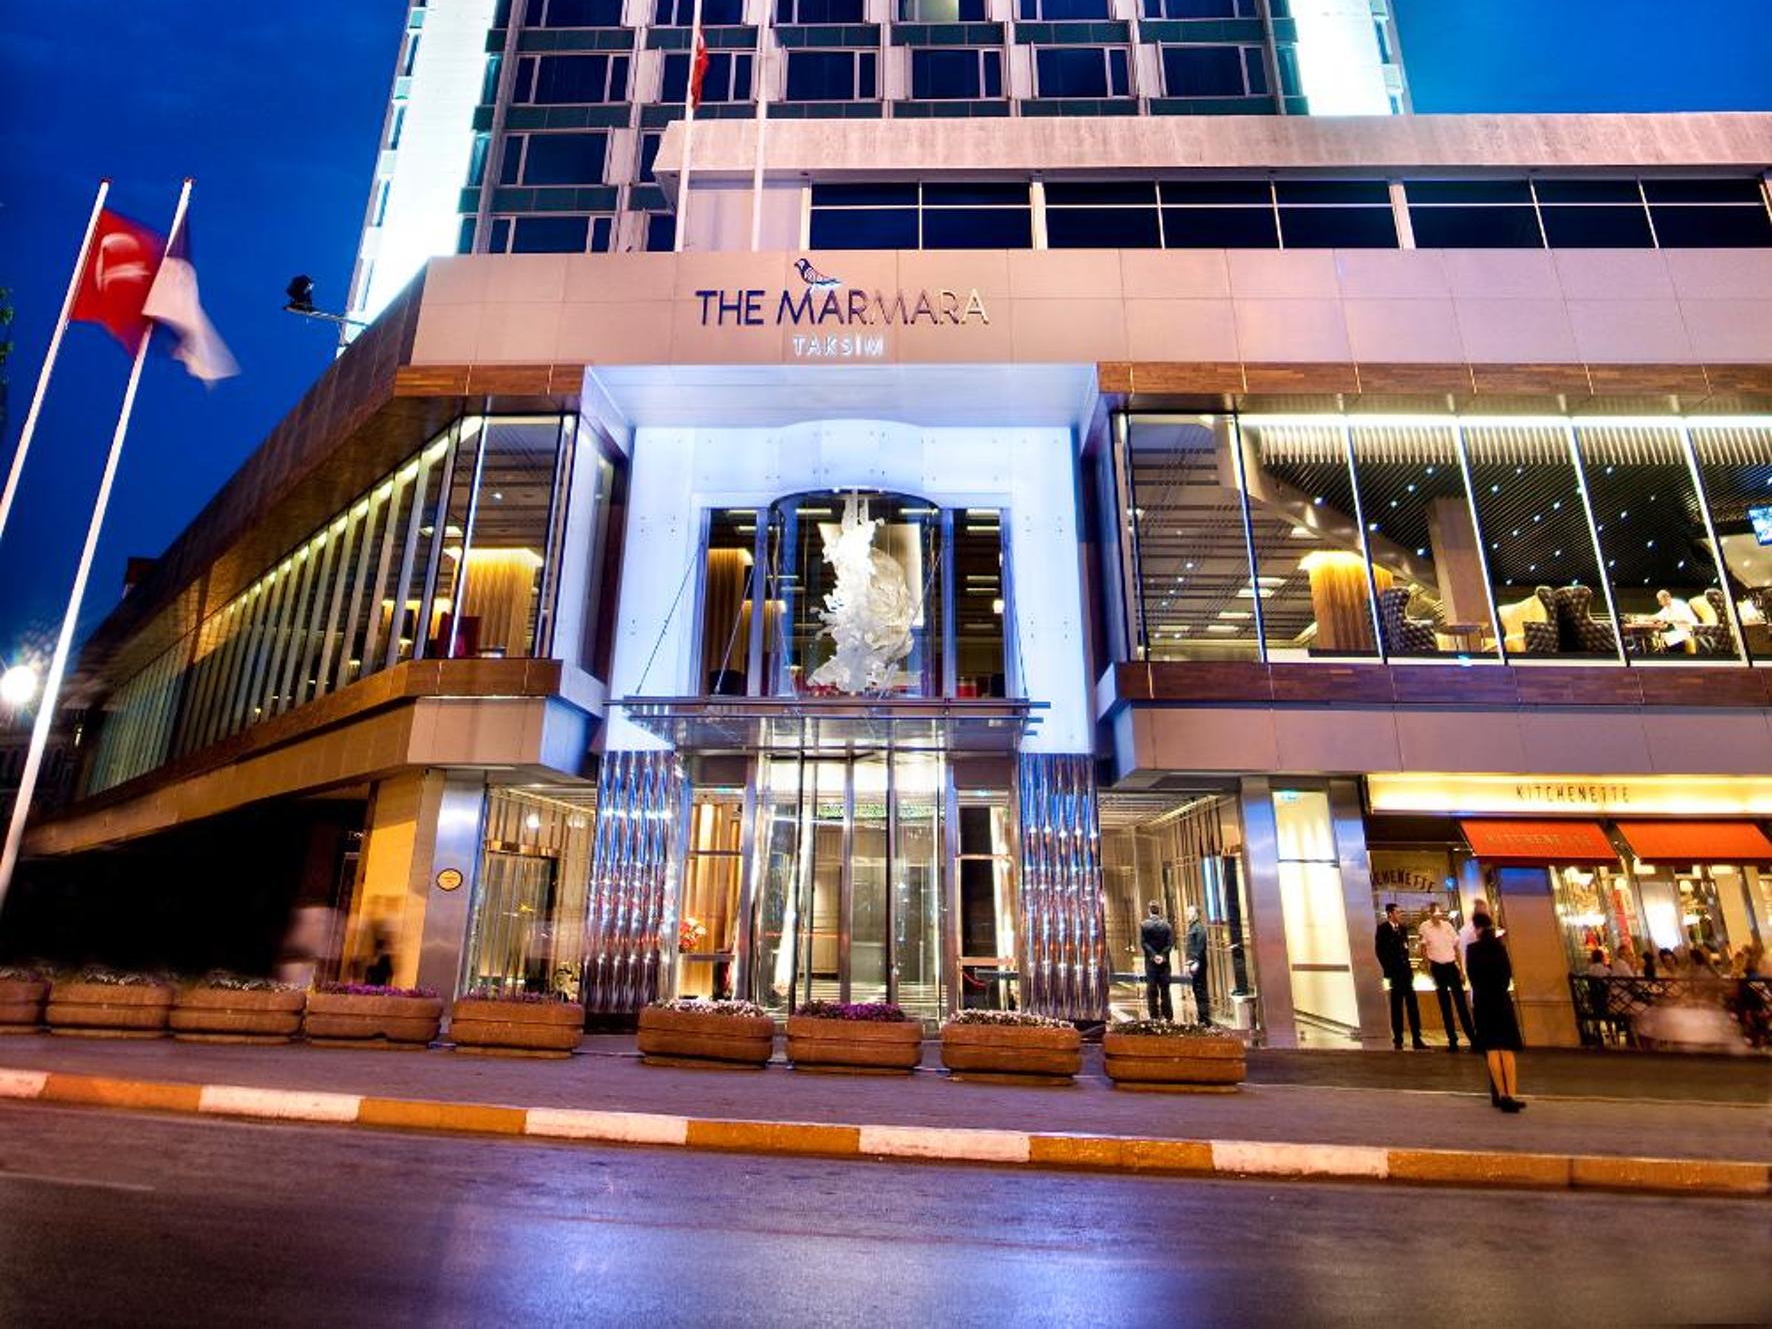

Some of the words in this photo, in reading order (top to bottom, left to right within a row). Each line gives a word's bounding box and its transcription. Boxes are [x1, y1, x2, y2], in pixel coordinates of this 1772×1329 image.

[695, 289, 765, 326] THE
[776, 288, 990, 326] MARMARA
[1515, 783, 1630, 803] KITCHENETTE
